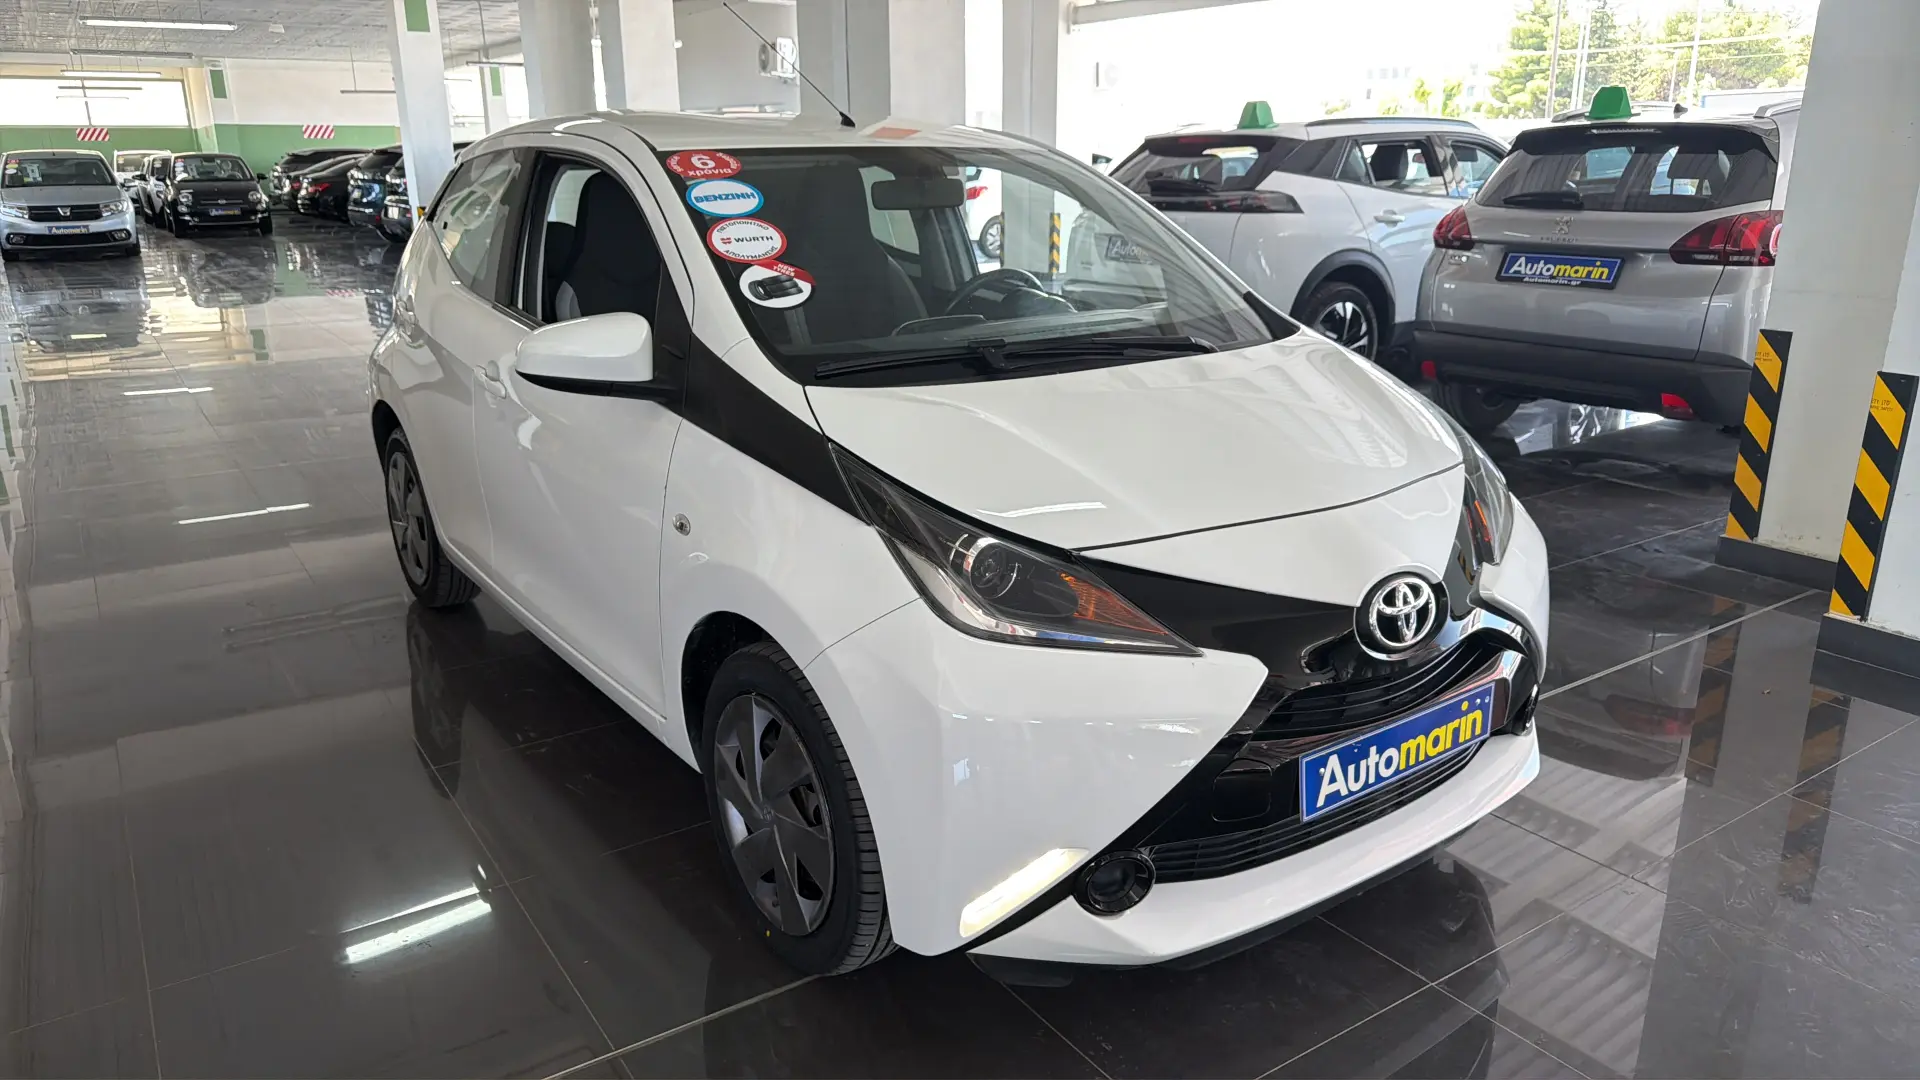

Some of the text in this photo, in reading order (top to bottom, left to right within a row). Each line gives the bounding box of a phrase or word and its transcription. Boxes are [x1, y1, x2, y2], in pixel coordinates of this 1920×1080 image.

[691, 155, 716, 169] 6
[688, 168, 733, 176] χρόνια
[777, 263, 796, 272] NEW
[1508, 256, 1609, 280] Automarin
[1522, 276, 1582, 286] Automarin.gr
[1316, 700, 1483, 808] Automarin
